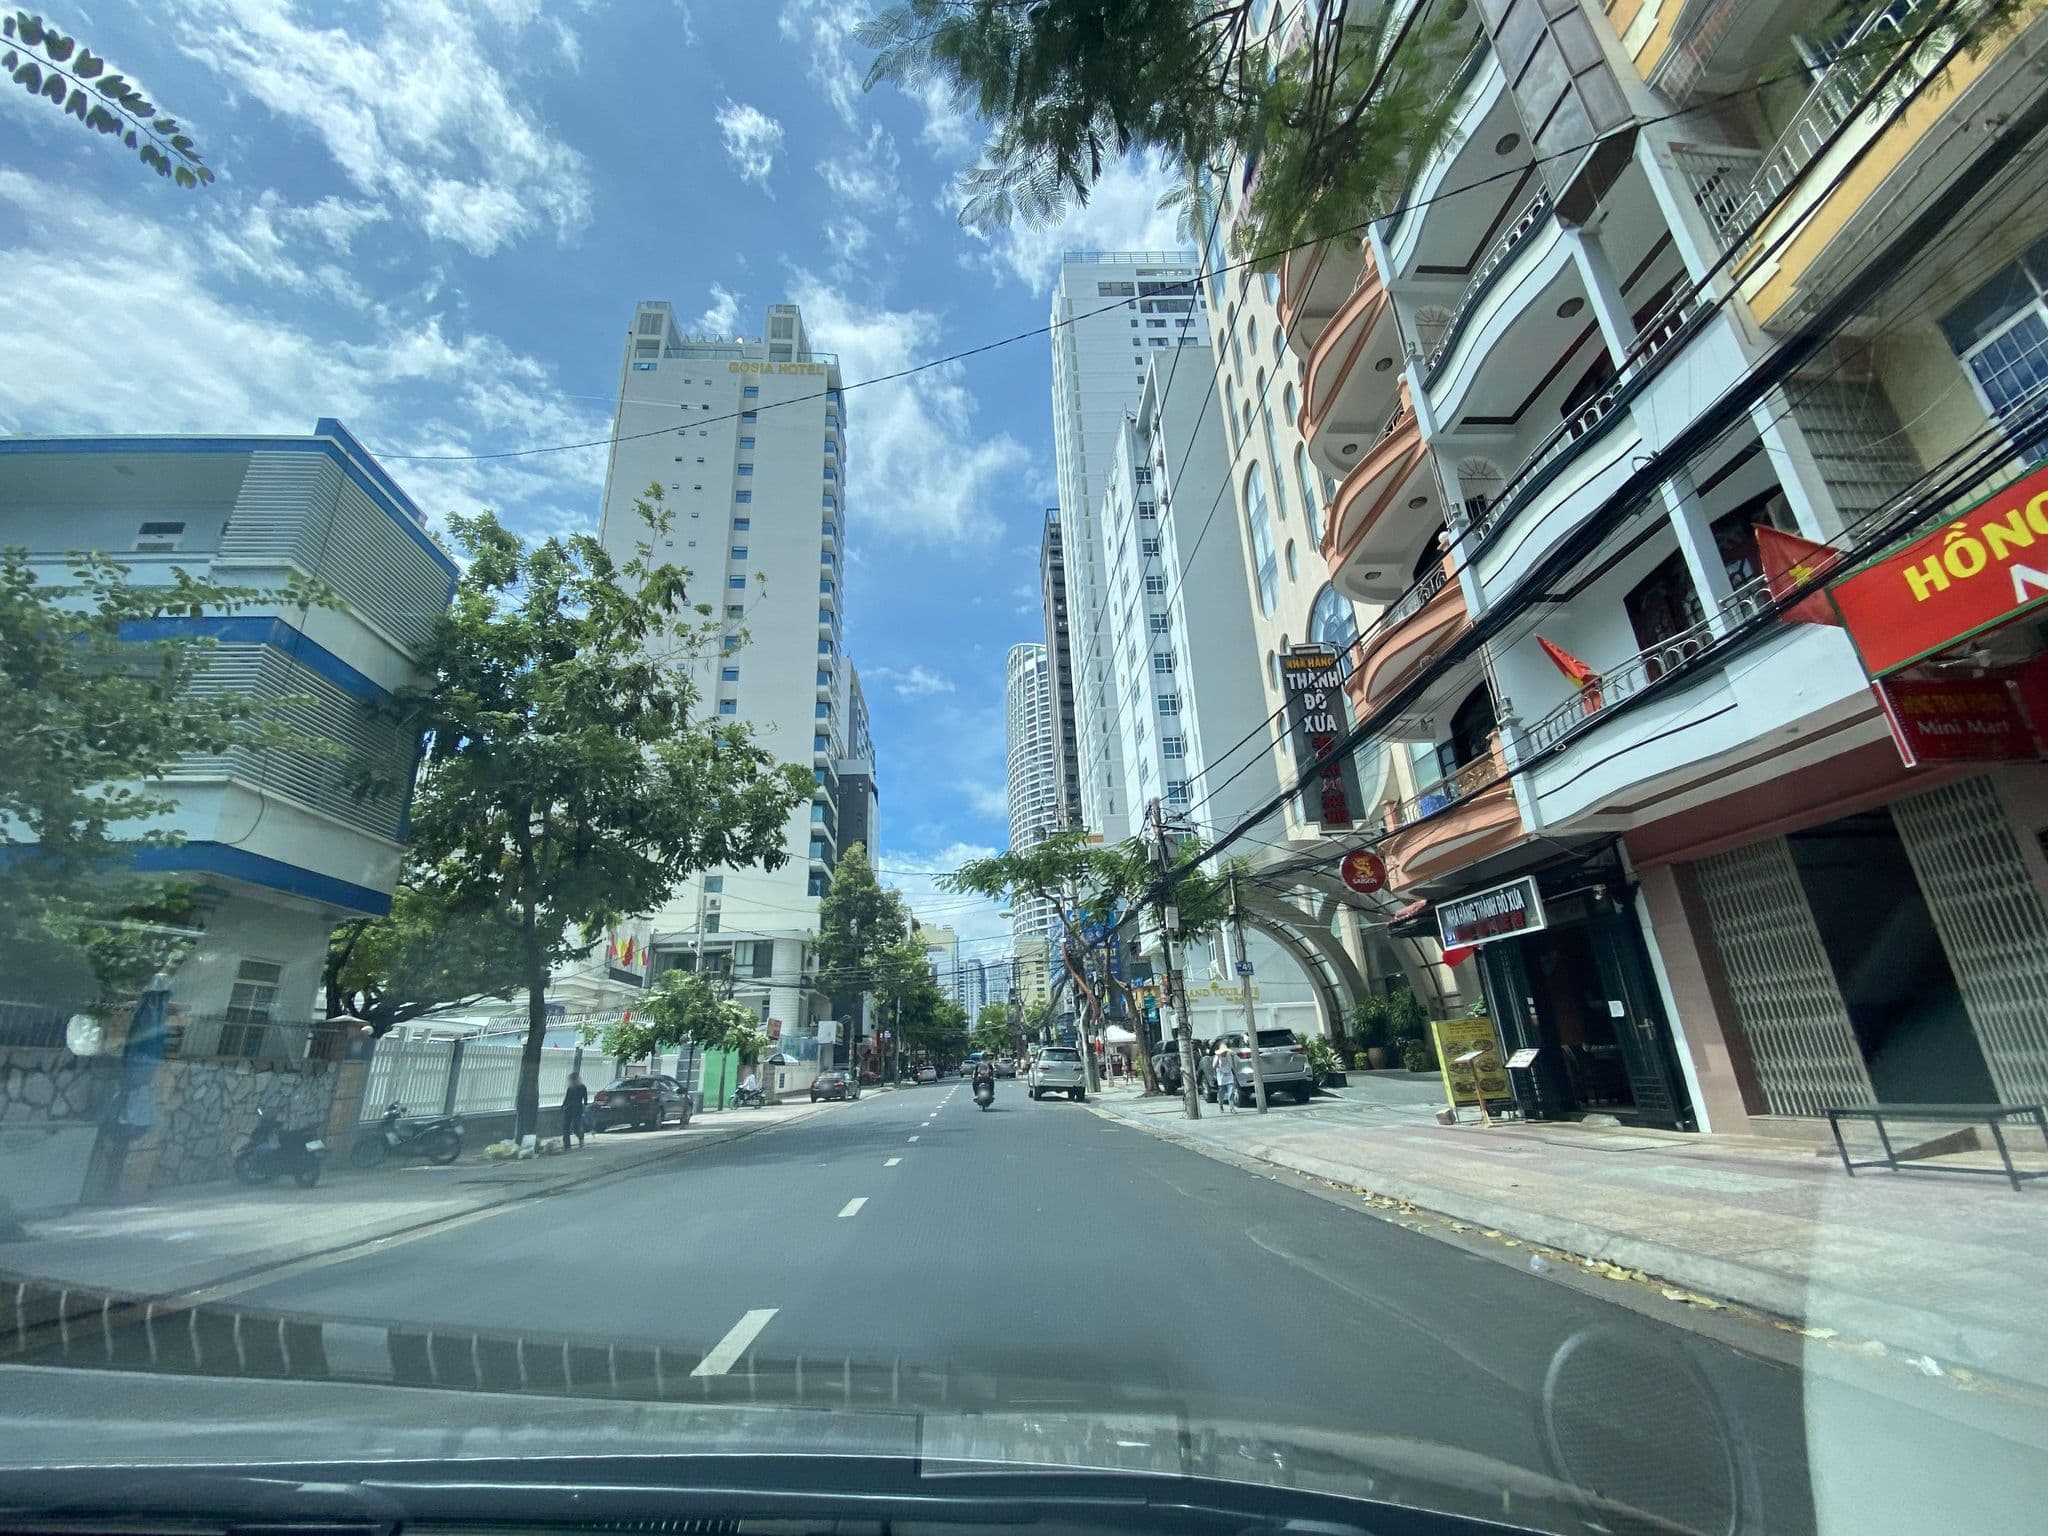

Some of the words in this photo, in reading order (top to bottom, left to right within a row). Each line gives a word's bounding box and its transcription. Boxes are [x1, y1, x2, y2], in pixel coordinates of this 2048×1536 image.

[729, 361, 773, 374] GOSIA
[779, 362, 824, 375] HOTEL
[1286, 668, 1340, 690] THÀNH
[1304, 689, 1327, 711] ĐÔ
[1303, 713, 1338, 733] XƯA
[1915, 718, 1963, 735] Mini
[1966, 718, 2009, 735] Mart
